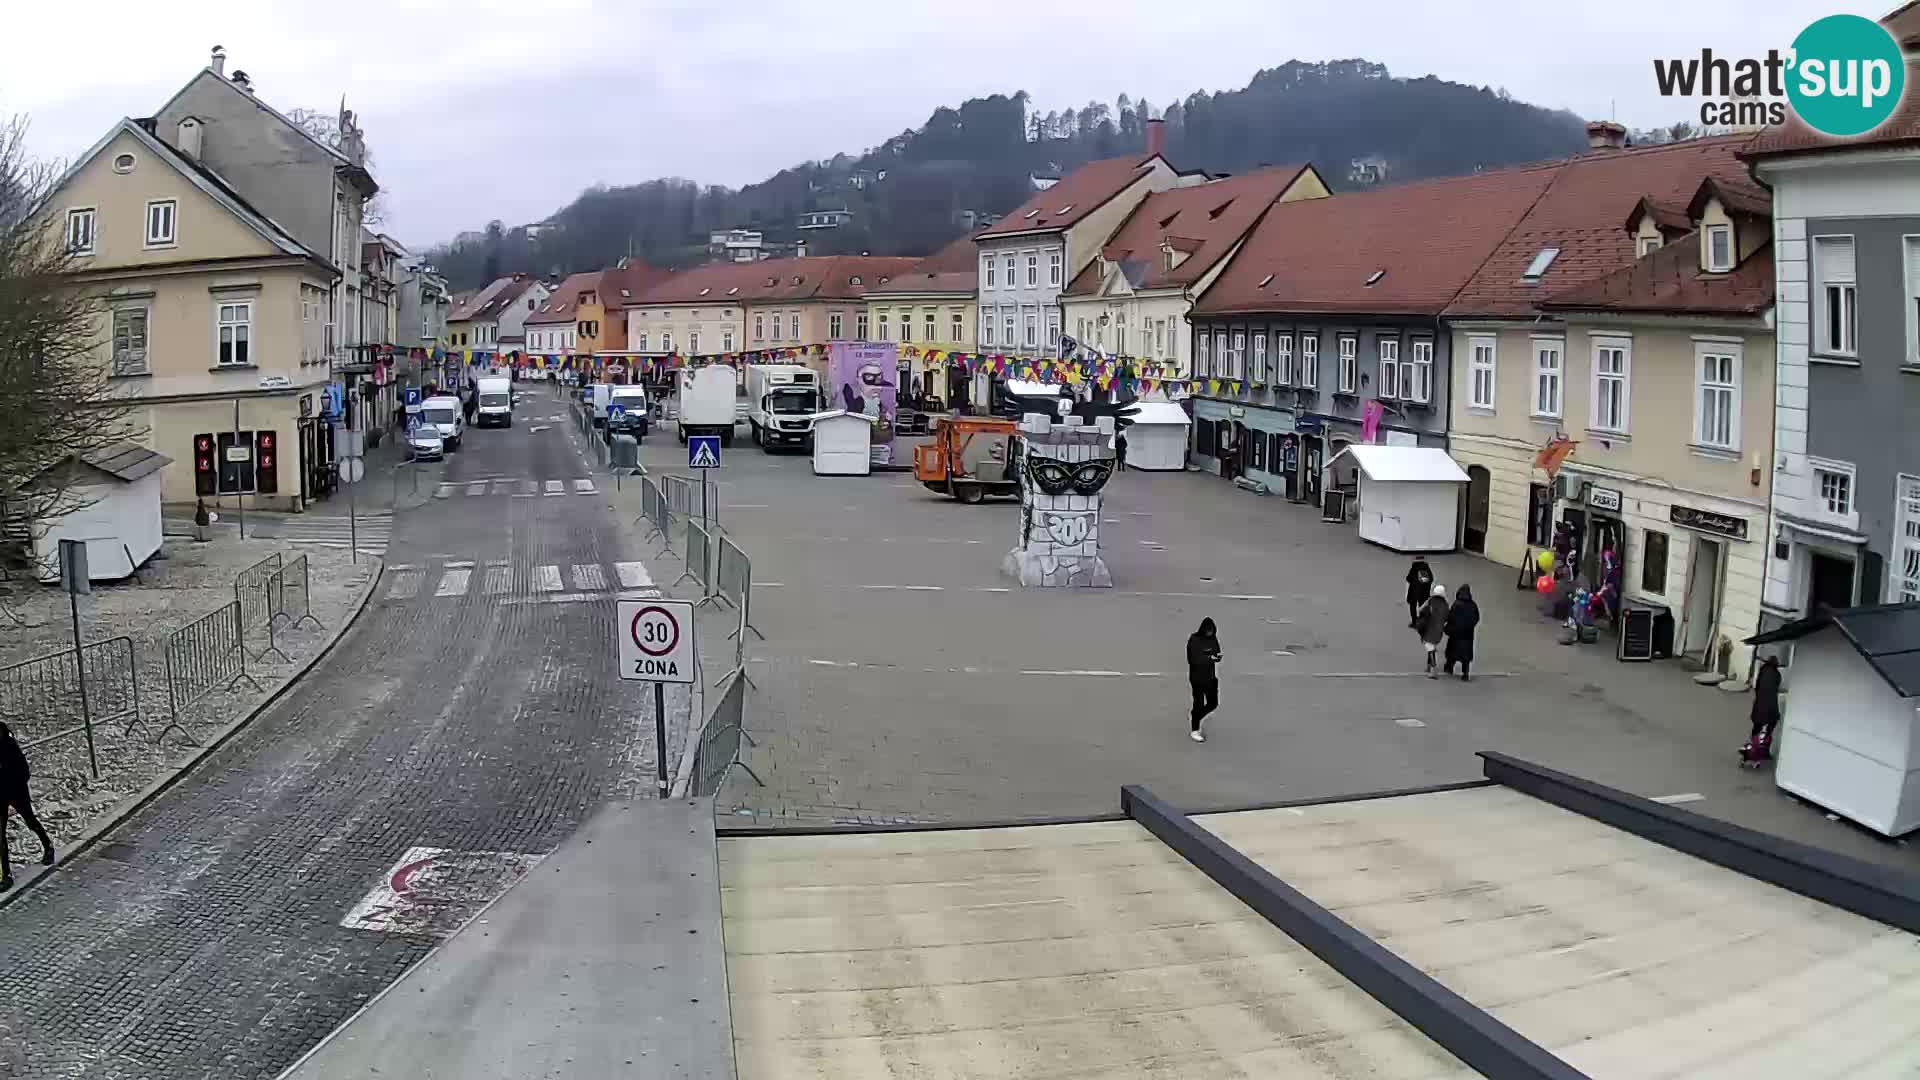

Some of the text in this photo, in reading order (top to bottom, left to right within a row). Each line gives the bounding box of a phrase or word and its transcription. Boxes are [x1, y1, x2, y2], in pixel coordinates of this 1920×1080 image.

[1048, 514, 1087, 545] 200
[644, 622, 668, 643] 30
[634, 659, 679, 676] ZONA
